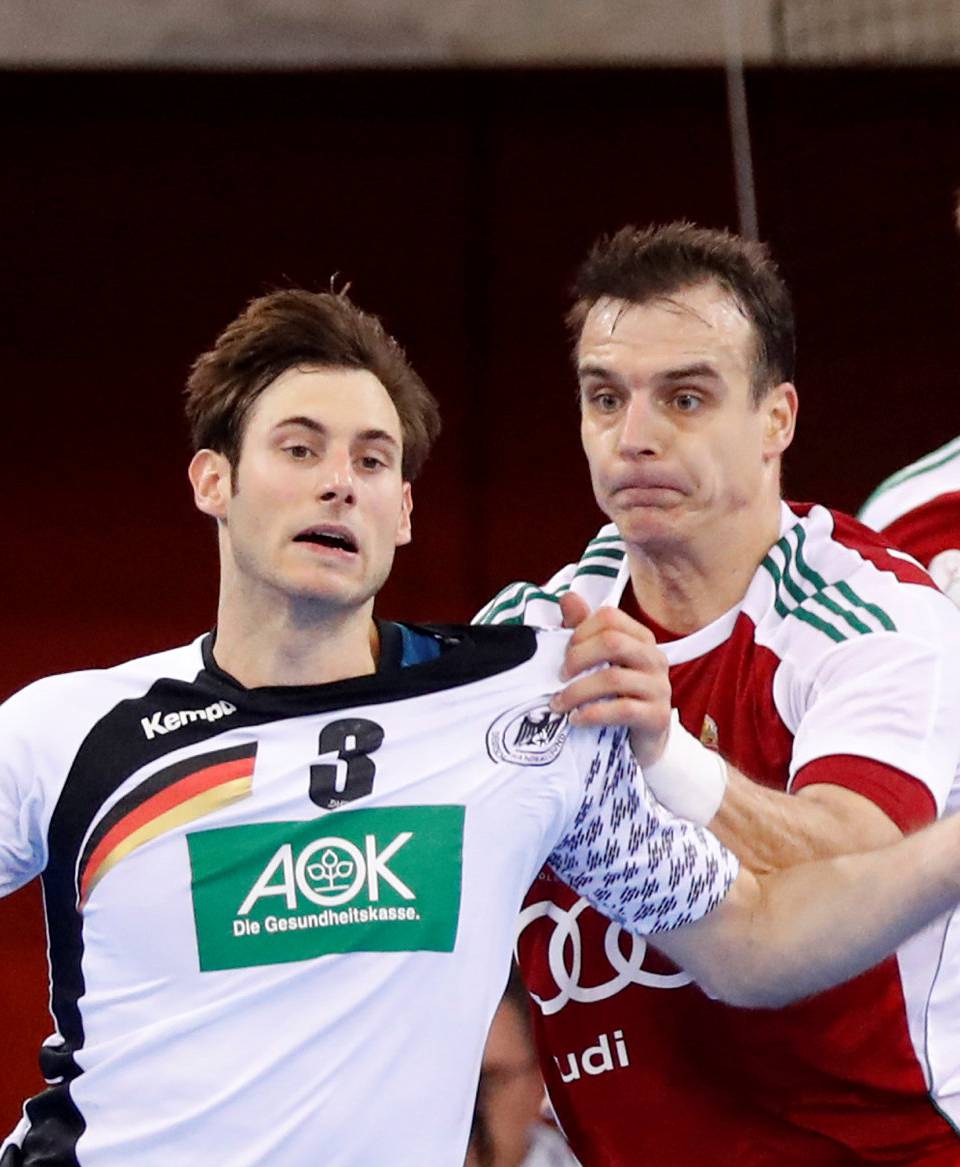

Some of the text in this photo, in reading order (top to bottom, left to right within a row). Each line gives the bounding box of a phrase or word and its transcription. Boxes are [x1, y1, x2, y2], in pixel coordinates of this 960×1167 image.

[309, 717, 385, 811] 3
[237, 831, 417, 916] AOK
[232, 905, 421, 937] Die Gesundheitskasse.
[553, 1029, 630, 1084] udi
